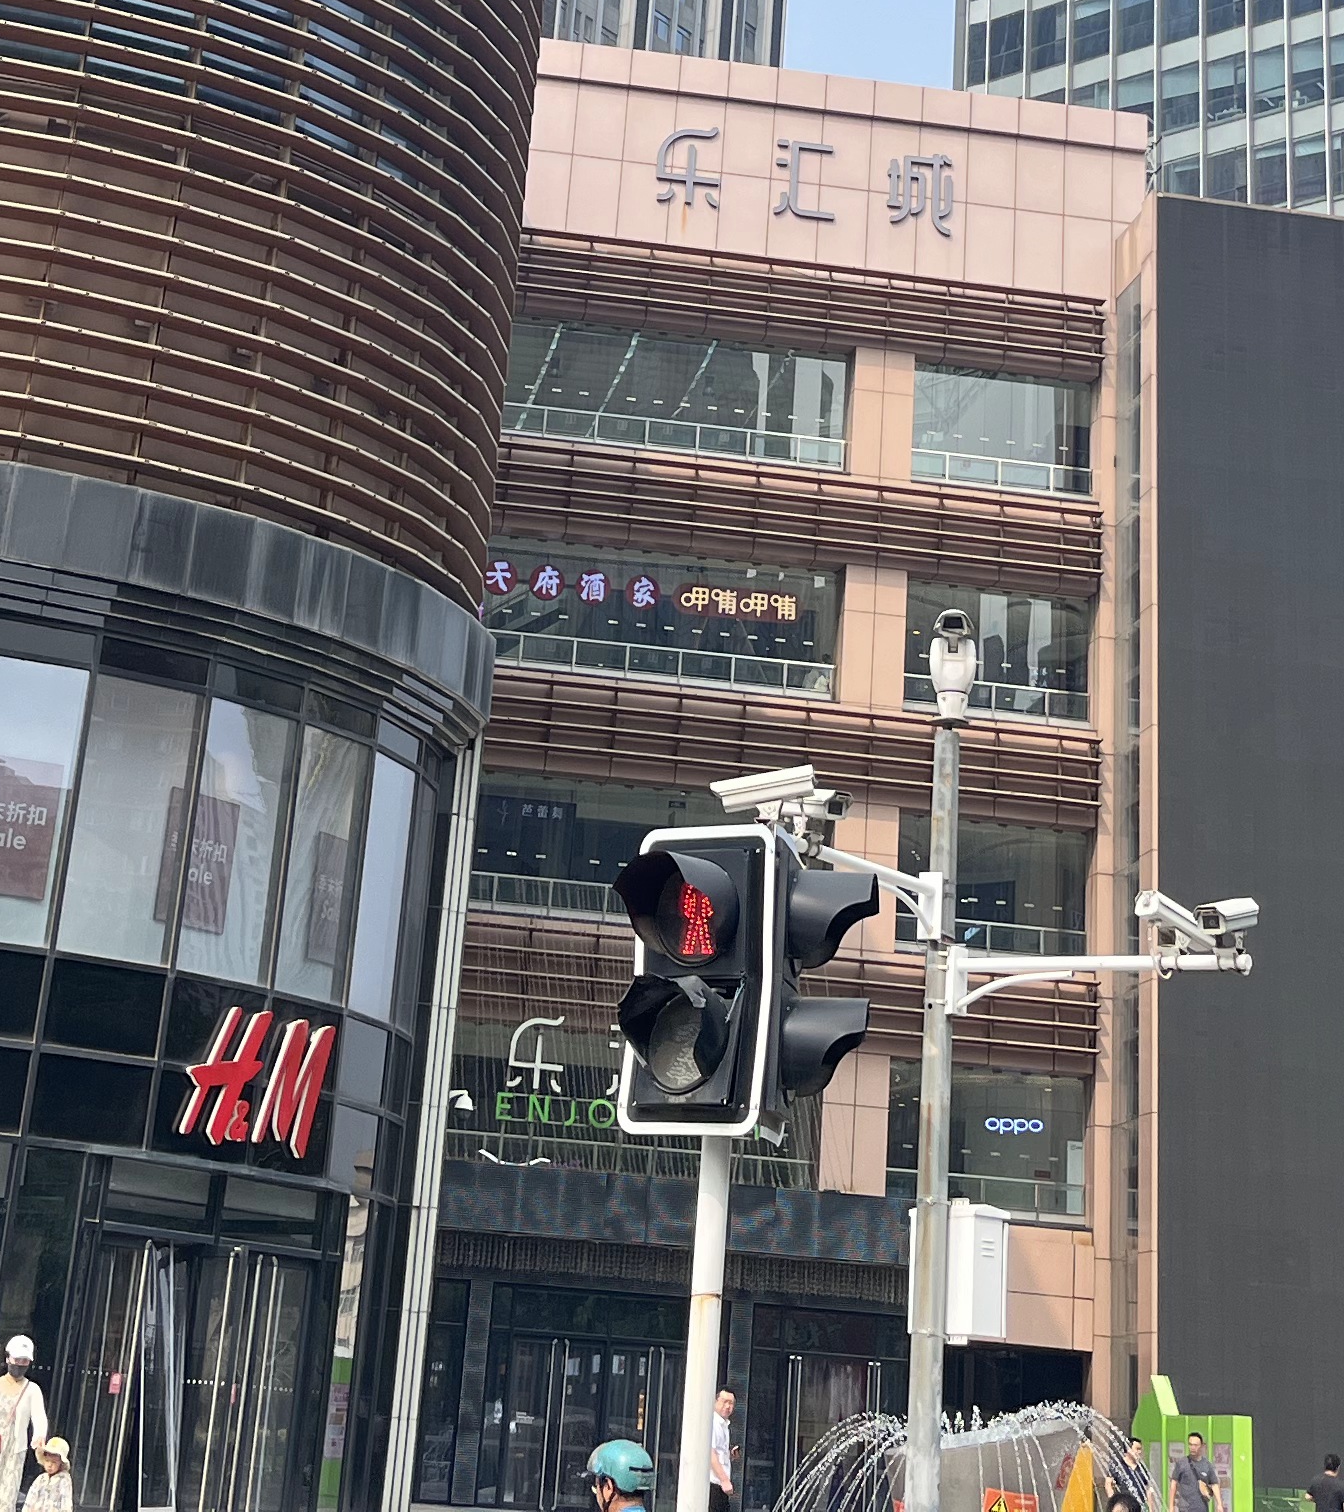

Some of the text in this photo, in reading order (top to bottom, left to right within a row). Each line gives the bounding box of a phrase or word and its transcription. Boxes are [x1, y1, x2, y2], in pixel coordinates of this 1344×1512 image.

[655, 126, 955, 237] 乐汇城
[486, 561, 655, 608] 天府酒家
[680, 586, 797, 622] 呷哺呷哺
[187, 863, 213, 886] ale
[179, 1005, 336, 1160] H&M
[495, 1091, 616, 1129] ENJO
[984, 1116, 1044, 1136] oppo
